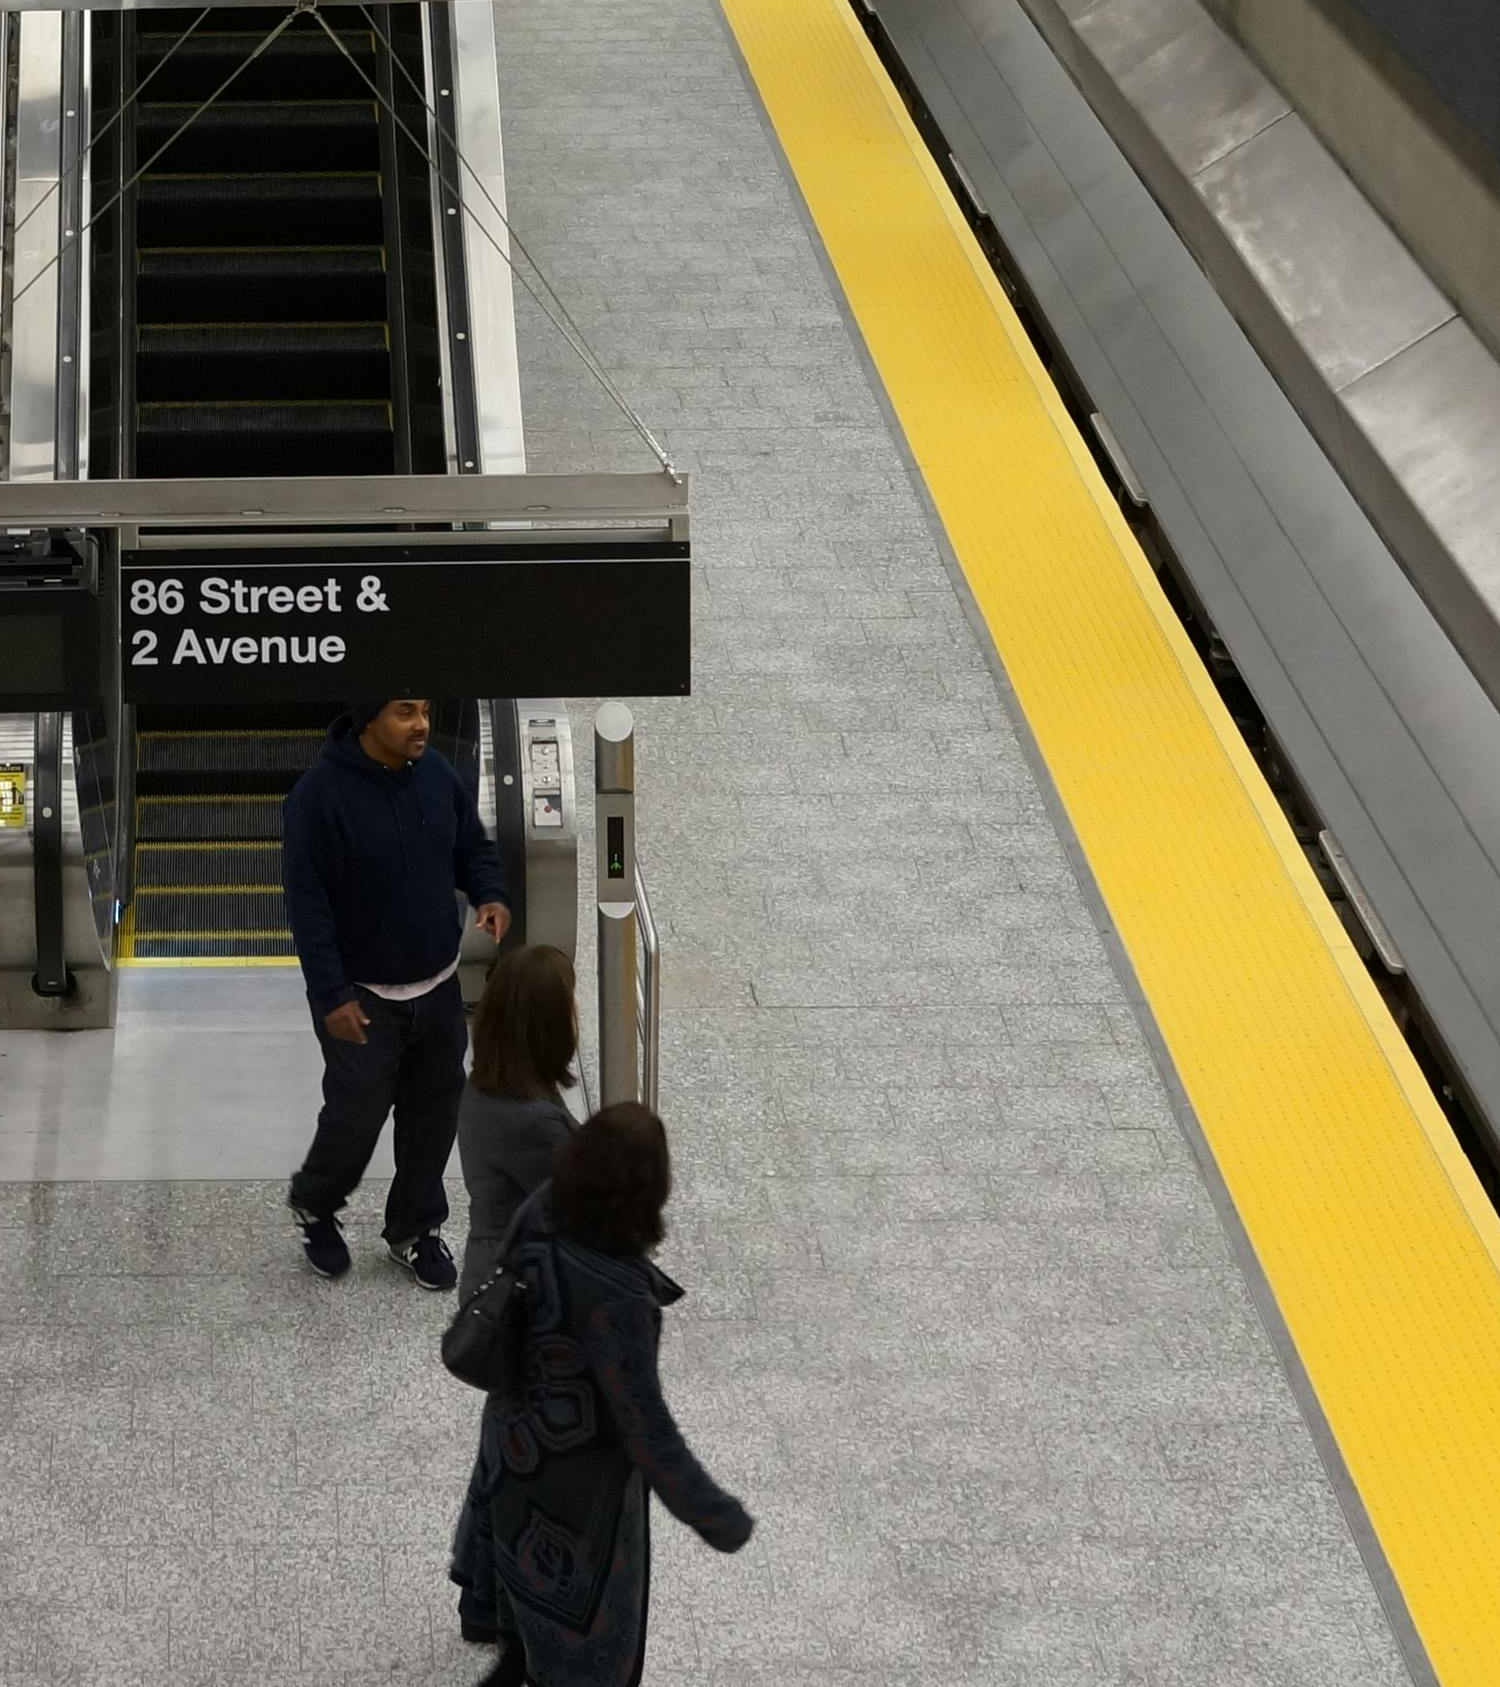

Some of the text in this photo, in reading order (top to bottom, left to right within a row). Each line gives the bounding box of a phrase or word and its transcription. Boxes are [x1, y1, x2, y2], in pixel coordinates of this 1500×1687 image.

[130, 574, 391, 616] 86 Street &
[131, 628, 347, 666] 2 Avenue
